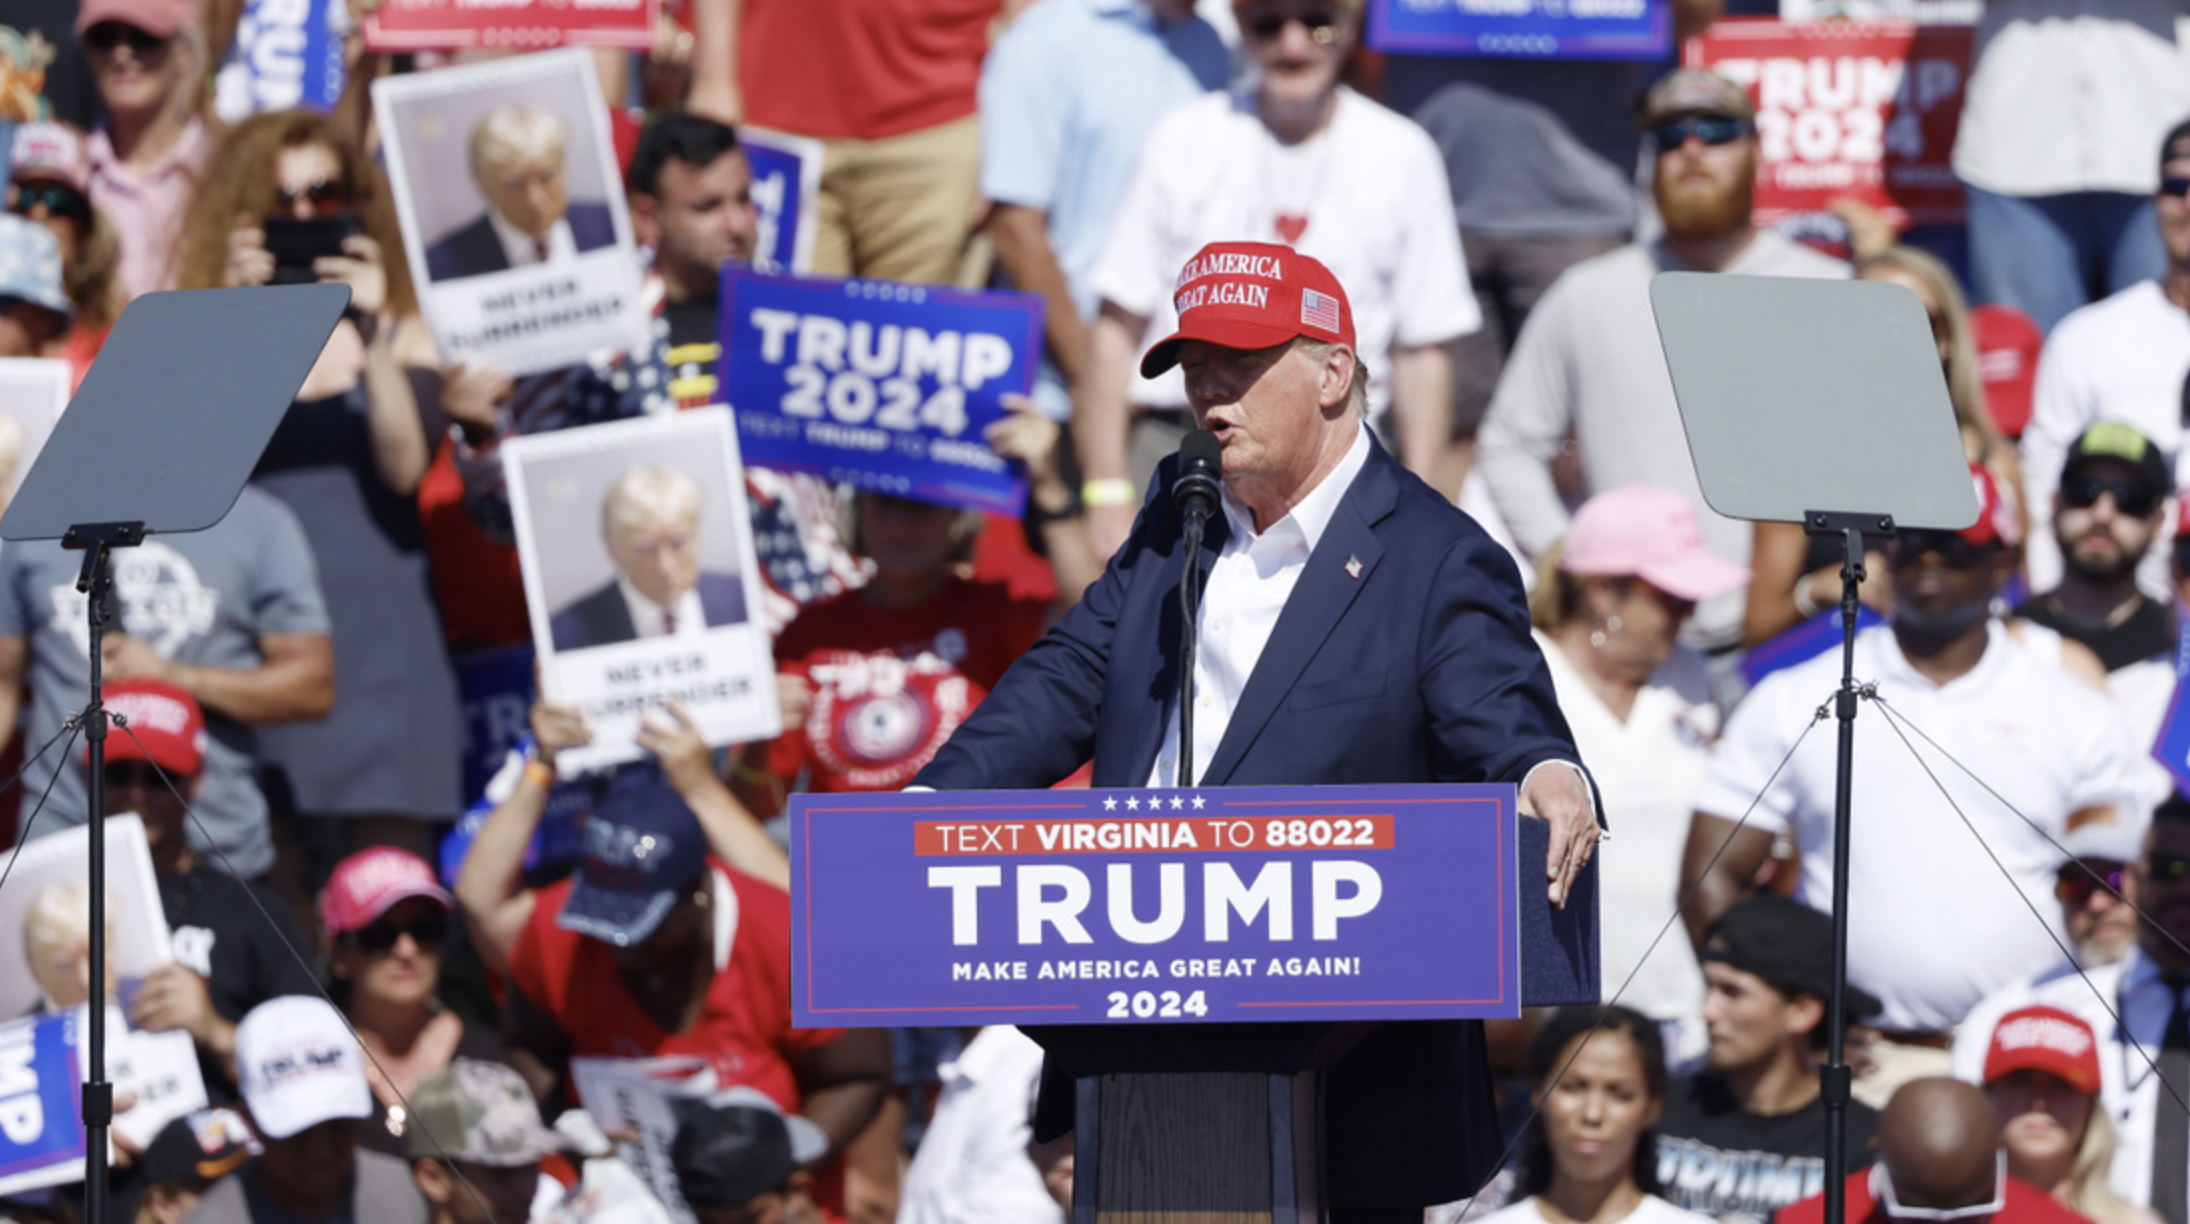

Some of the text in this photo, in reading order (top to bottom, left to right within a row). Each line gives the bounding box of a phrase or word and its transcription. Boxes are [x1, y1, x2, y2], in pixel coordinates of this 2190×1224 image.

[1200, 252, 1283, 282] AMERICA
[1206, 282, 1270, 310] AGAIN
[751, 307, 1013, 390] TRUMP
[781, 362, 969, 436] 2024
[935, 819, 1375, 852] TEXT VIRGINIA TO 88022
[927, 860, 1384, 946] TRUMP
[952, 956, 1361, 981] MAKE AMERICA GREAT AGAIN!
[1106, 990, 1209, 1019] 2024
